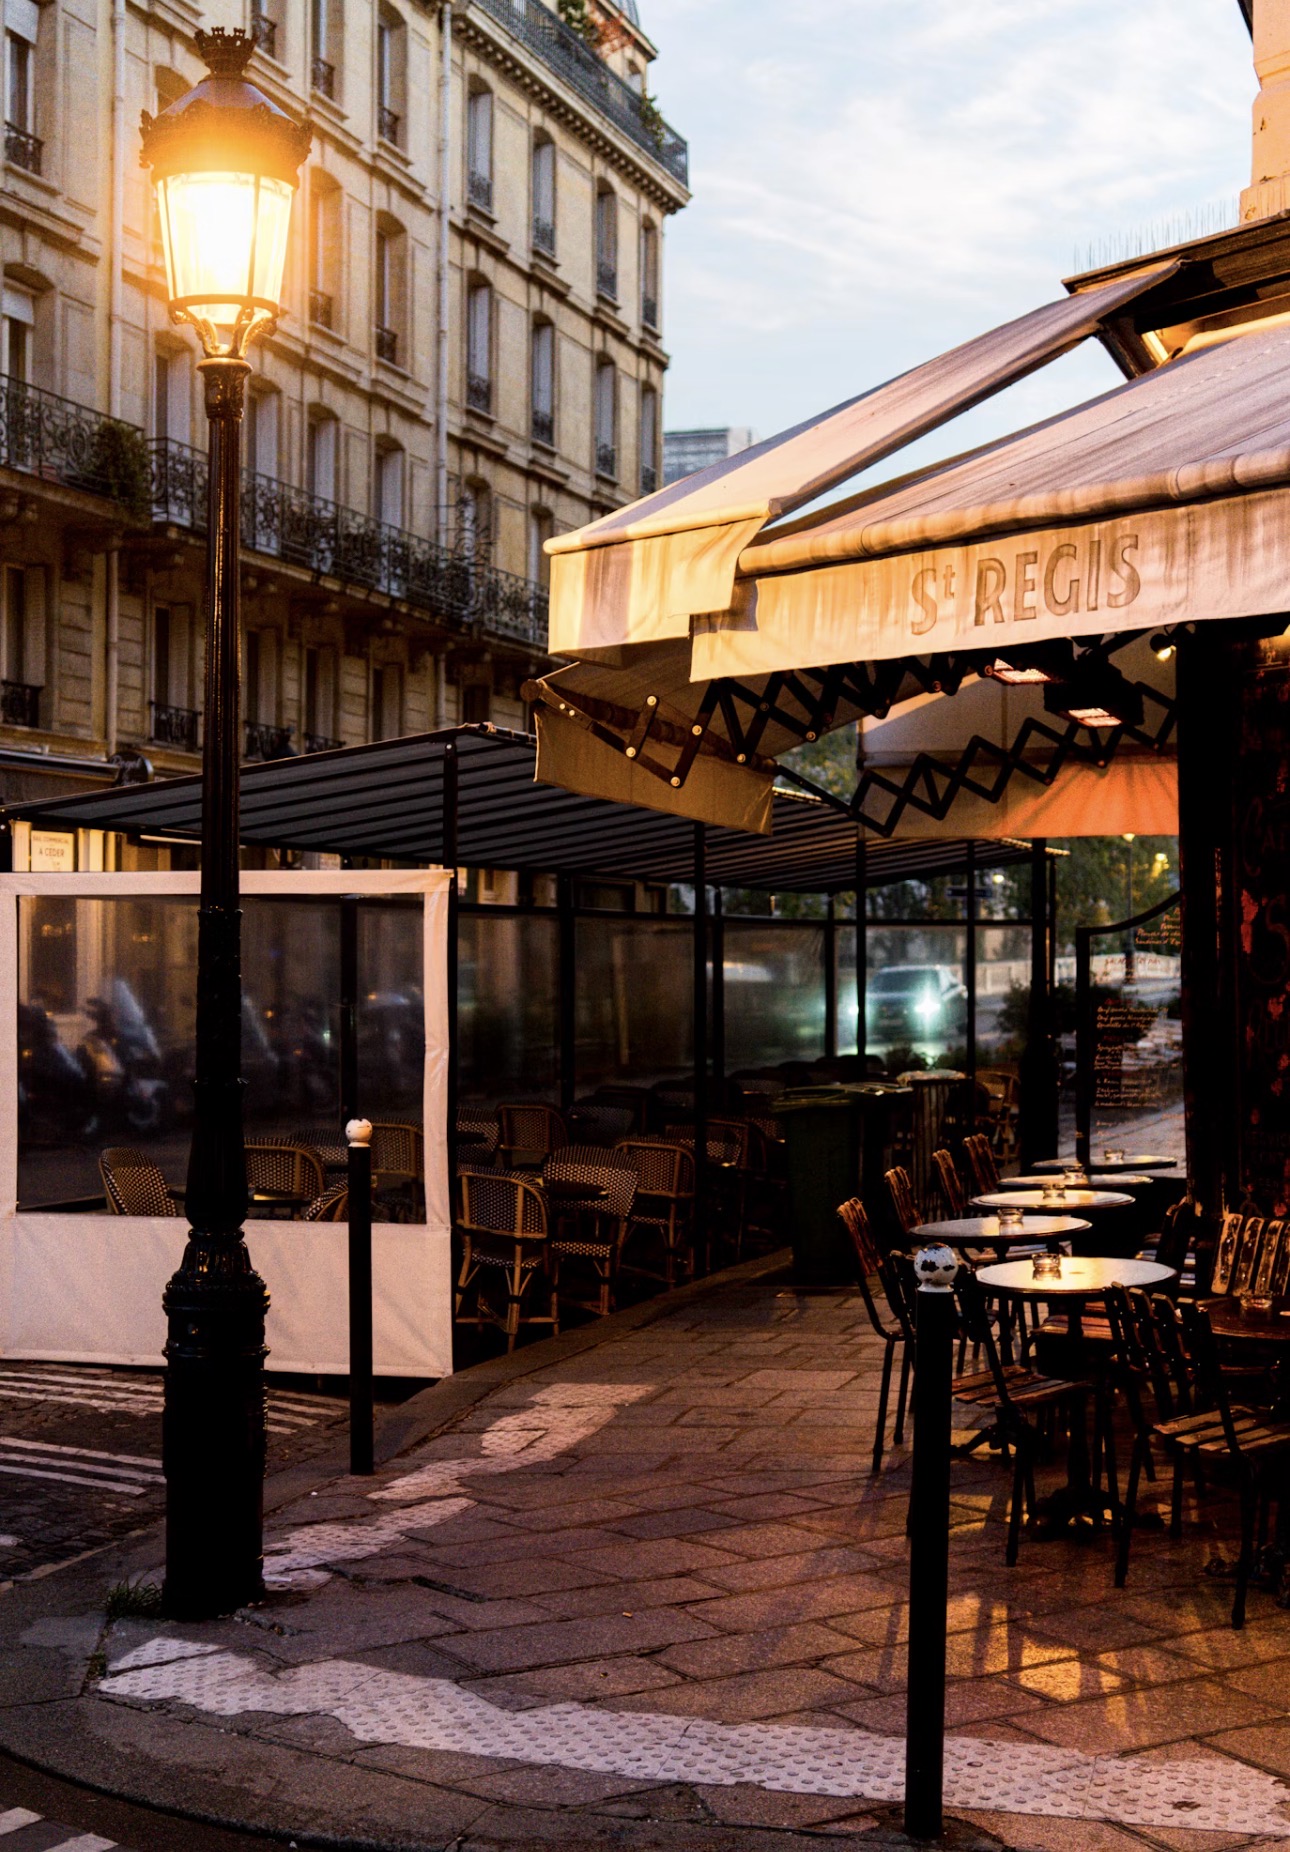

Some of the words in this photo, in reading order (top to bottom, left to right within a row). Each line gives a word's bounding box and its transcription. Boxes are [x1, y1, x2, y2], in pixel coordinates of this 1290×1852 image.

[911, 565, 955, 635] St
[973, 532, 1142, 627] REGIS
[45, 848, 65, 857] CEDER
